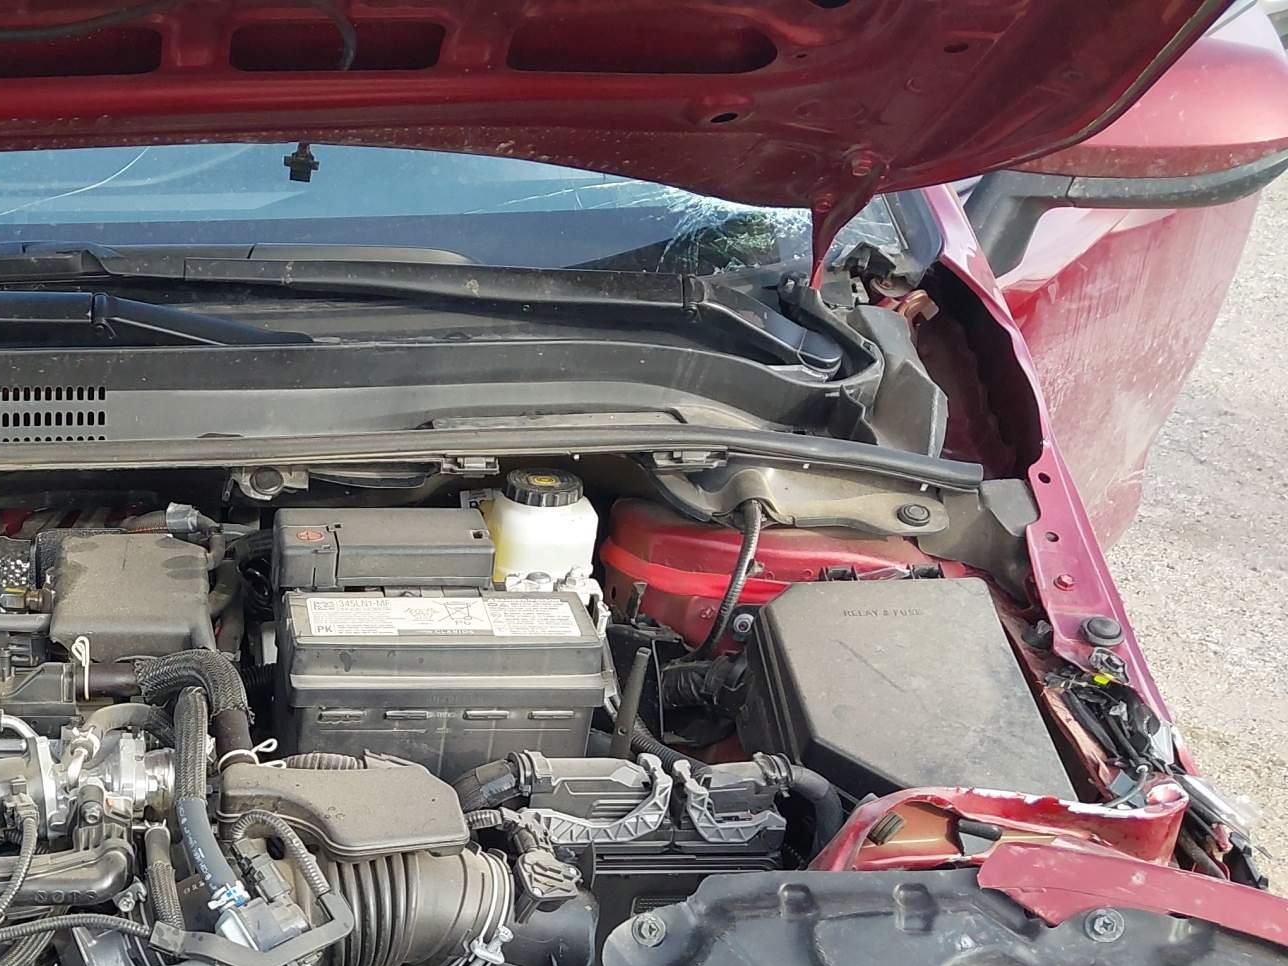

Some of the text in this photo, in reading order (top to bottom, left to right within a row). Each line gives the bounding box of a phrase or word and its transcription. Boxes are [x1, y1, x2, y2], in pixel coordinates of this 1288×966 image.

[843, 608, 878, 616] RELAY
[893, 608, 921, 616] FUSE
[317, 625, 333, 633] PK
